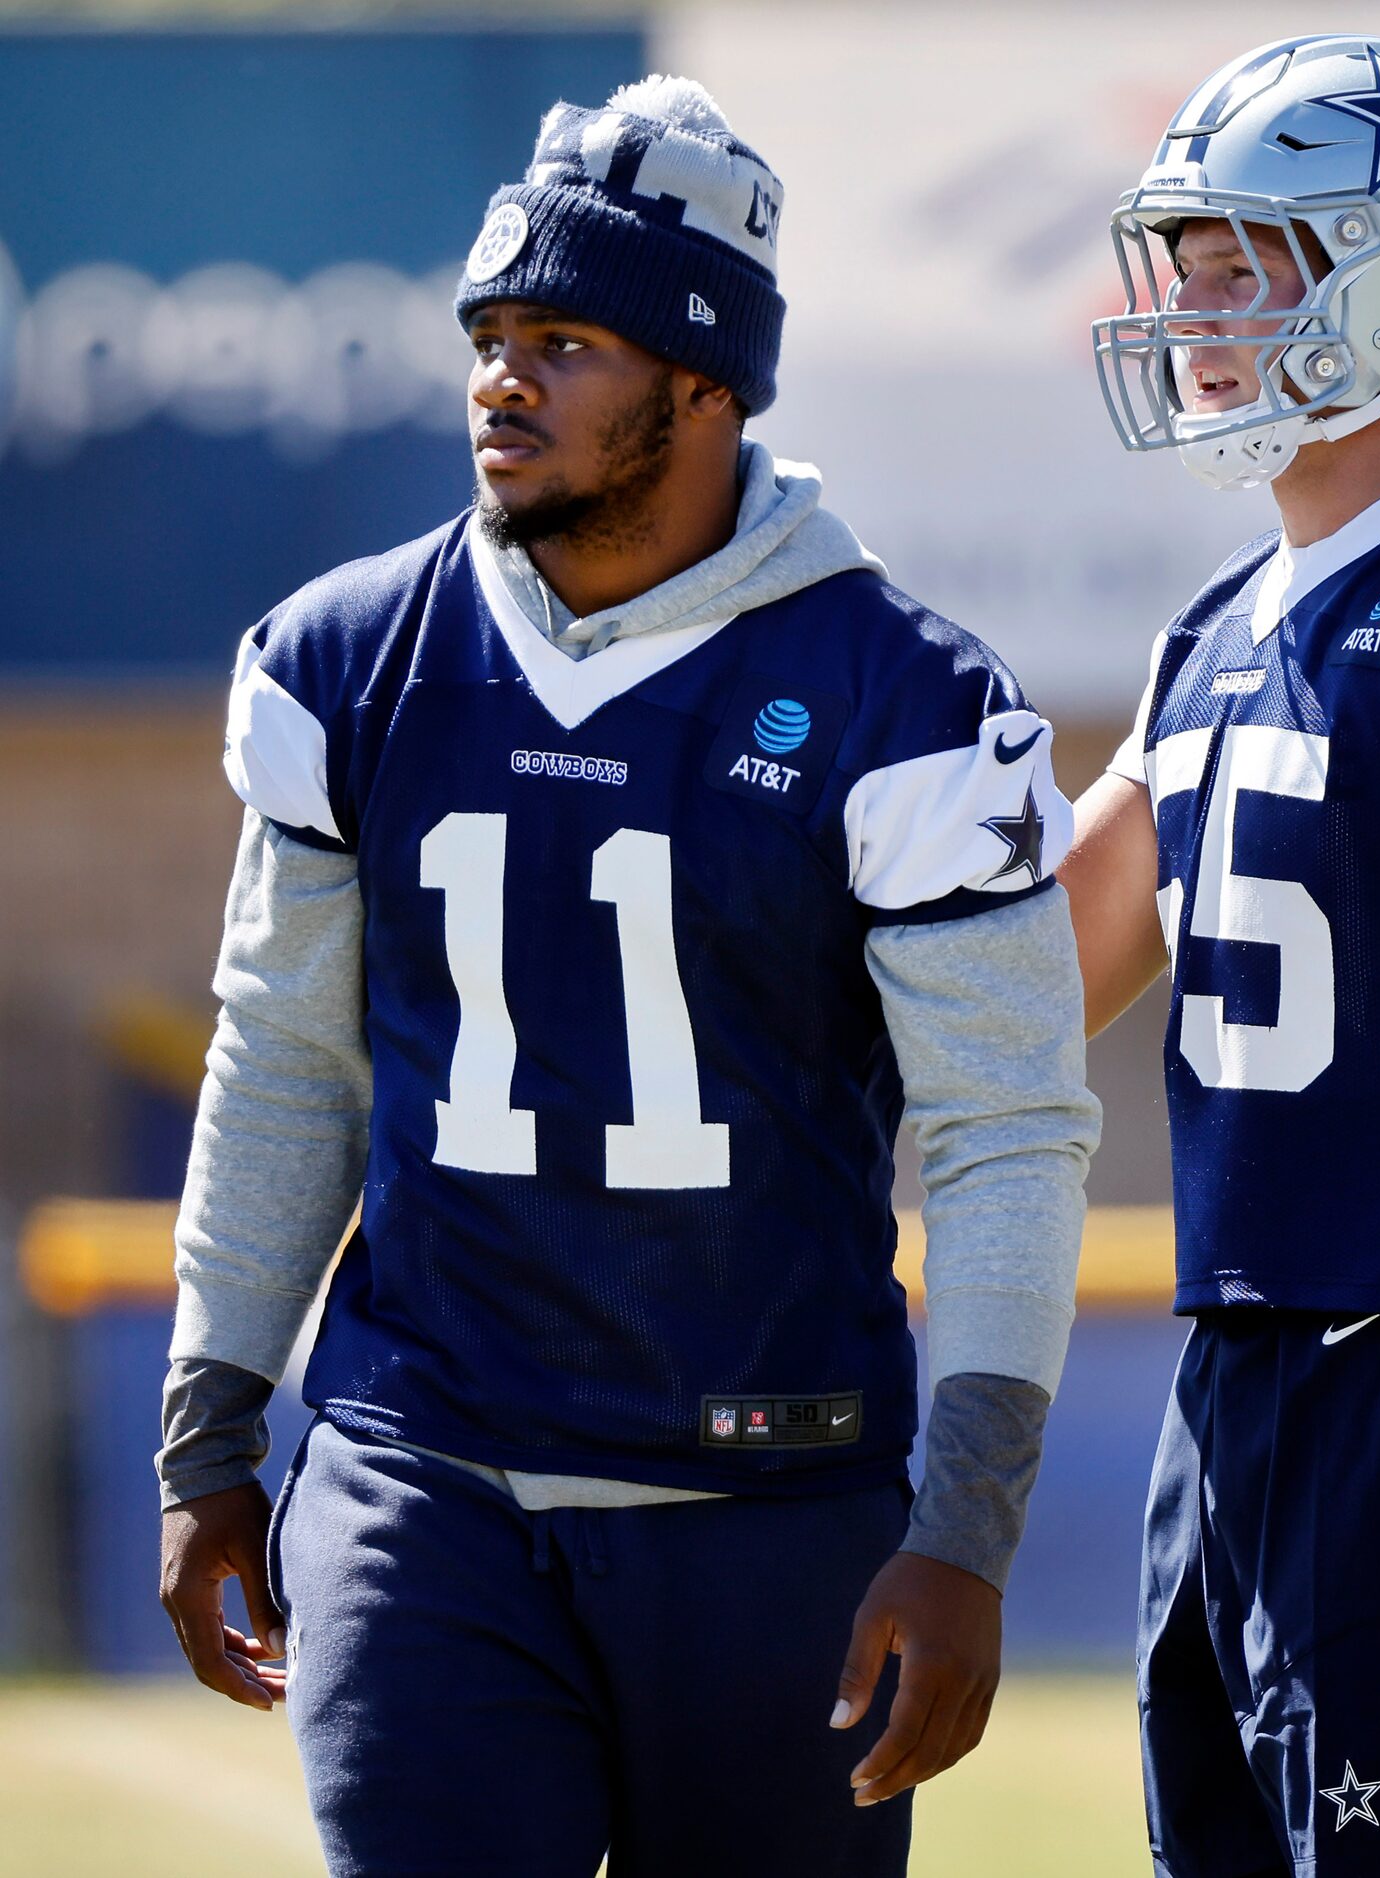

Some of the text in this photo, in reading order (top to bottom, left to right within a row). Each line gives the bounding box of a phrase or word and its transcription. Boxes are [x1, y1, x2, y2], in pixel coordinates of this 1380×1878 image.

[511, 750, 628, 785] COWBOYS
[728, 754, 801, 793] AT&T
[419, 812, 731, 1191] 11
[715, 1419, 732, 1432] NFL
[786, 1403, 818, 1424] 50
